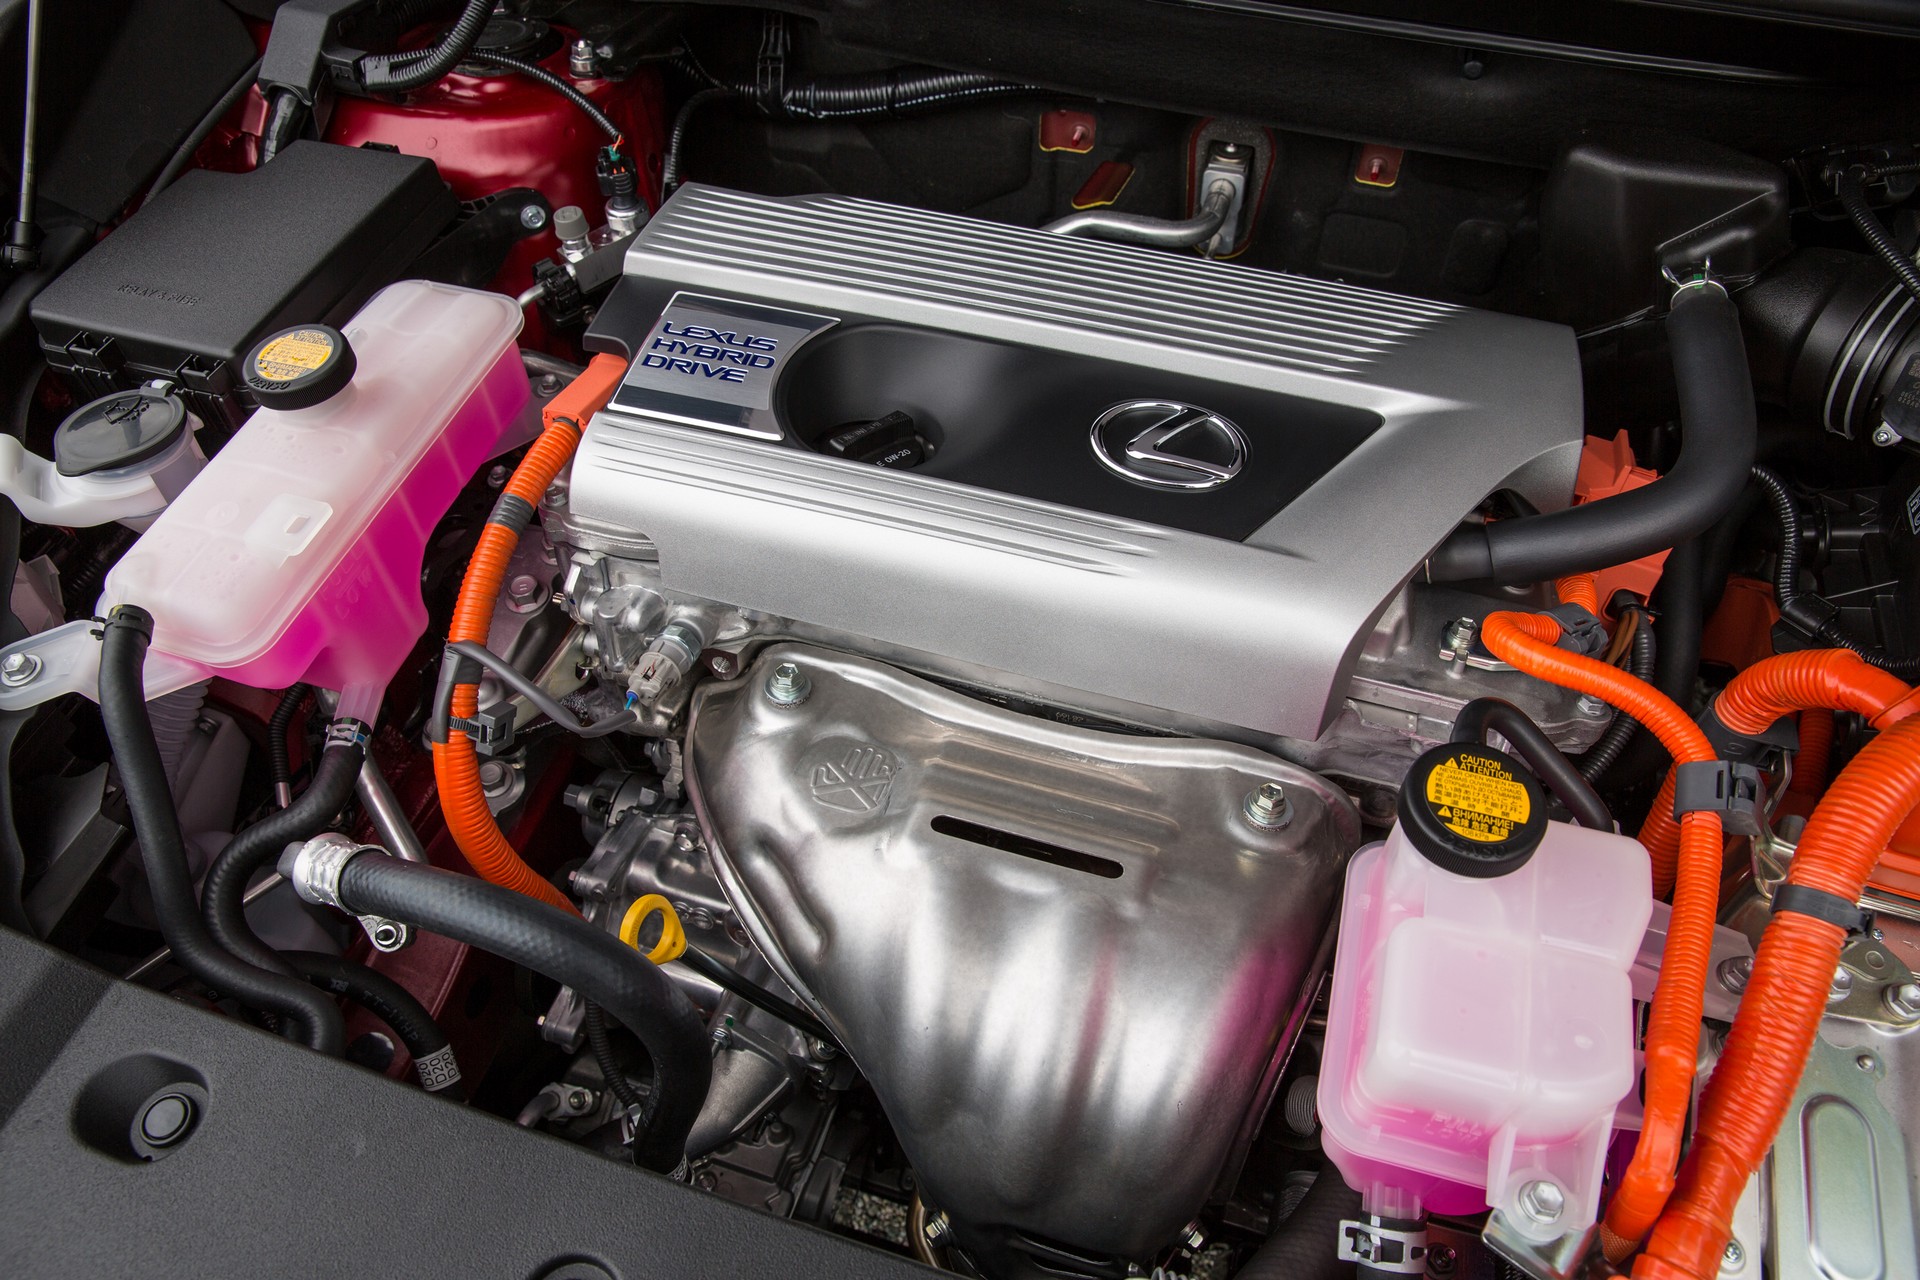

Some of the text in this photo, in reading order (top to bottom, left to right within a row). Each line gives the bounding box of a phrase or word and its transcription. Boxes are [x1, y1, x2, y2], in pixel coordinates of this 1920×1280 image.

[663, 321, 778, 352] LEXUS
[651, 336, 776, 369] HYBRID
[642, 353, 749, 383] DRIVE
[884, 448, 911, 464] 0W-20
[1460, 754, 1501, 770] CAUTION
[1460, 762, 1513, 781] ATTENTION
[1439, 767, 1463, 776] NEVER
[1464, 773, 1484, 781] OPEN
[1485, 777, 1507, 786] WHEN
[1446, 774, 1468, 783] JAMAIS
[1469, 779, 1492, 788] OUVRIR
[1452, 808, 1515, 830] ВНИМАНИЕ!
[419, 1062, 435, 1087] D20
[429, 1057, 447, 1084] D20
